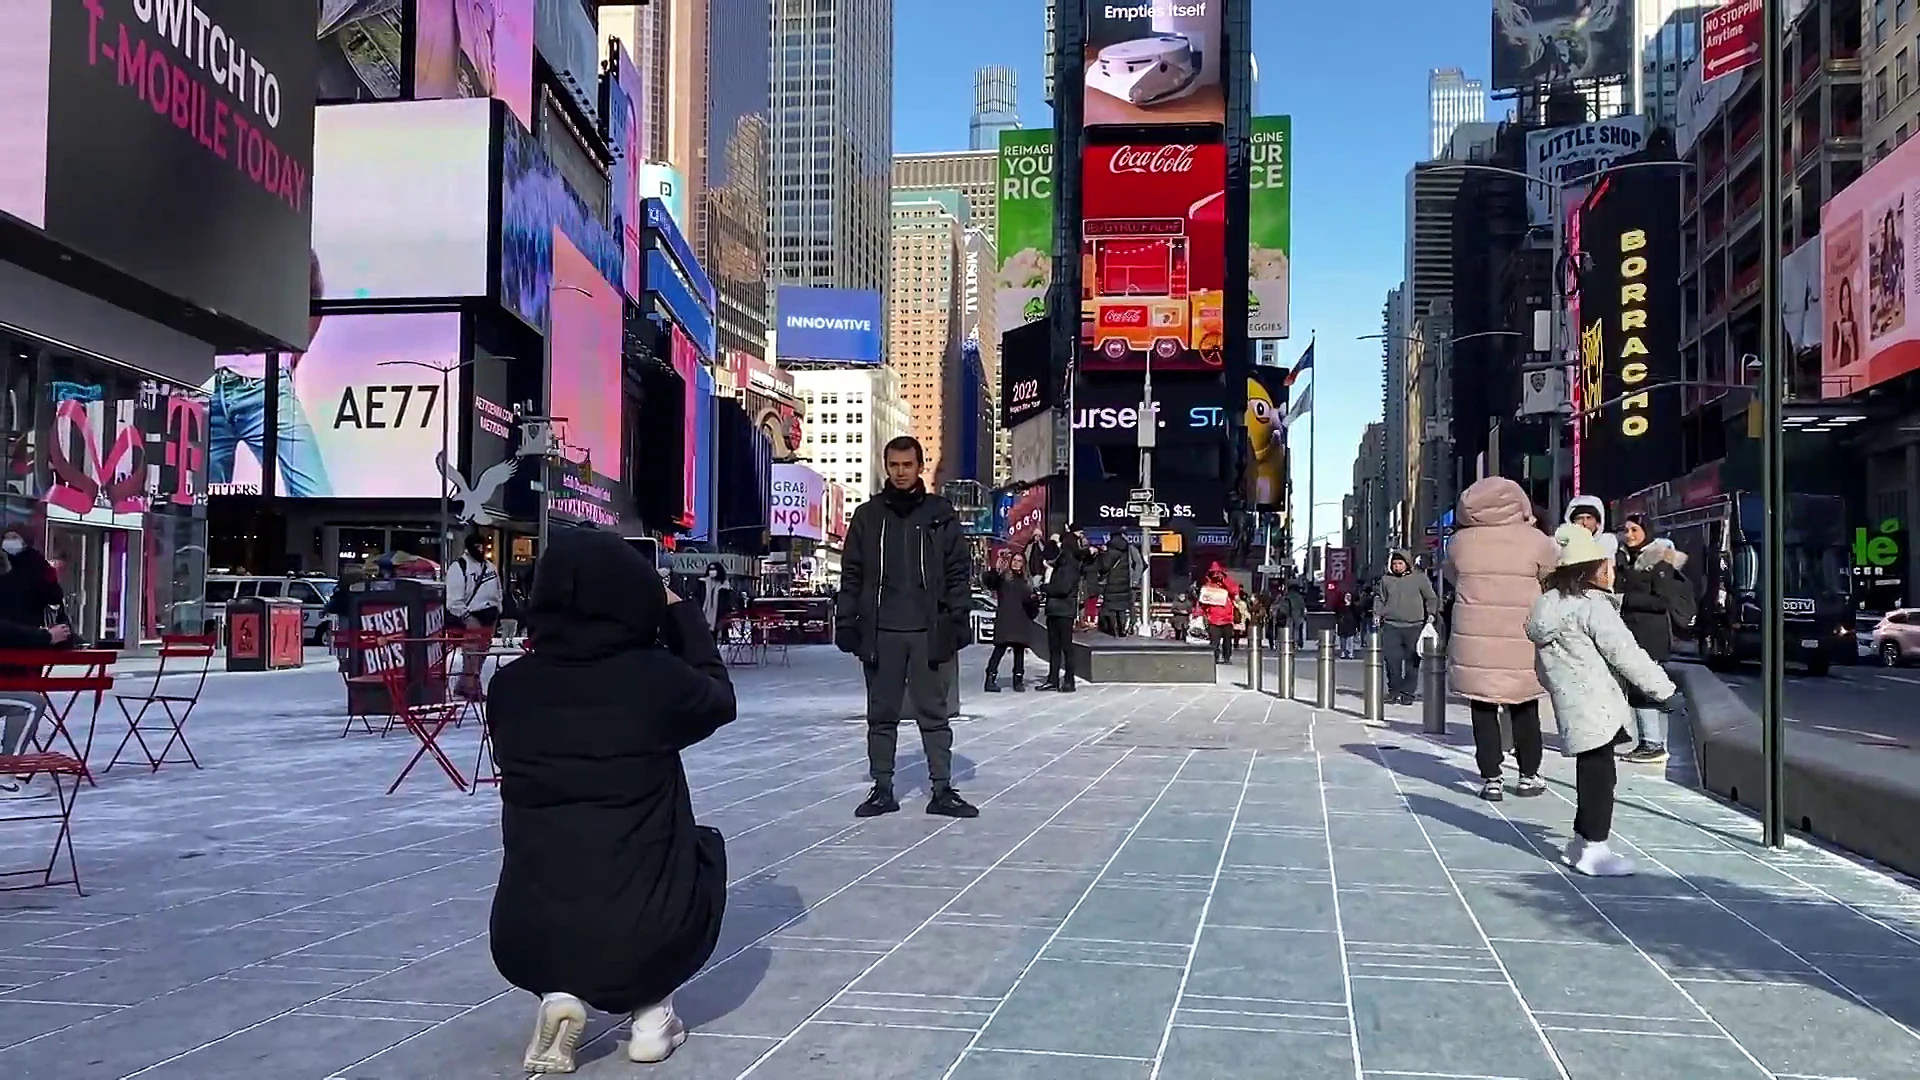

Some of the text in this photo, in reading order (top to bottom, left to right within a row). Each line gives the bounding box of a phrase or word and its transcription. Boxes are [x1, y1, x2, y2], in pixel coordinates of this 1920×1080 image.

[1104, 4, 1165, 21] Empties
[1705, 16, 1719, 33] NO
[1706, 23, 1744, 48] Anytime
[250, 56, 281, 128] TO
[83, 0, 305, 212] T-MOBILE TODAY
[1004, 144, 1053, 156] REIMAGI
[1251, 144, 1283, 163] UR
[1539, 125, 1642, 161] LITTLE SHOP
[1005, 156, 1053, 175] YOU
[1250, 165, 1284, 189] CE
[1004, 176, 1051, 200] RIC
[786, 316, 871, 331] INNOVATIVE
[1620, 229, 1649, 436] BORRACHO
[1012, 379, 1038, 402] 2022
[334, 386, 440, 429] AE77
[1173, 504, 1195, 518] $5.
[360, 606, 409, 635] JERSEY
